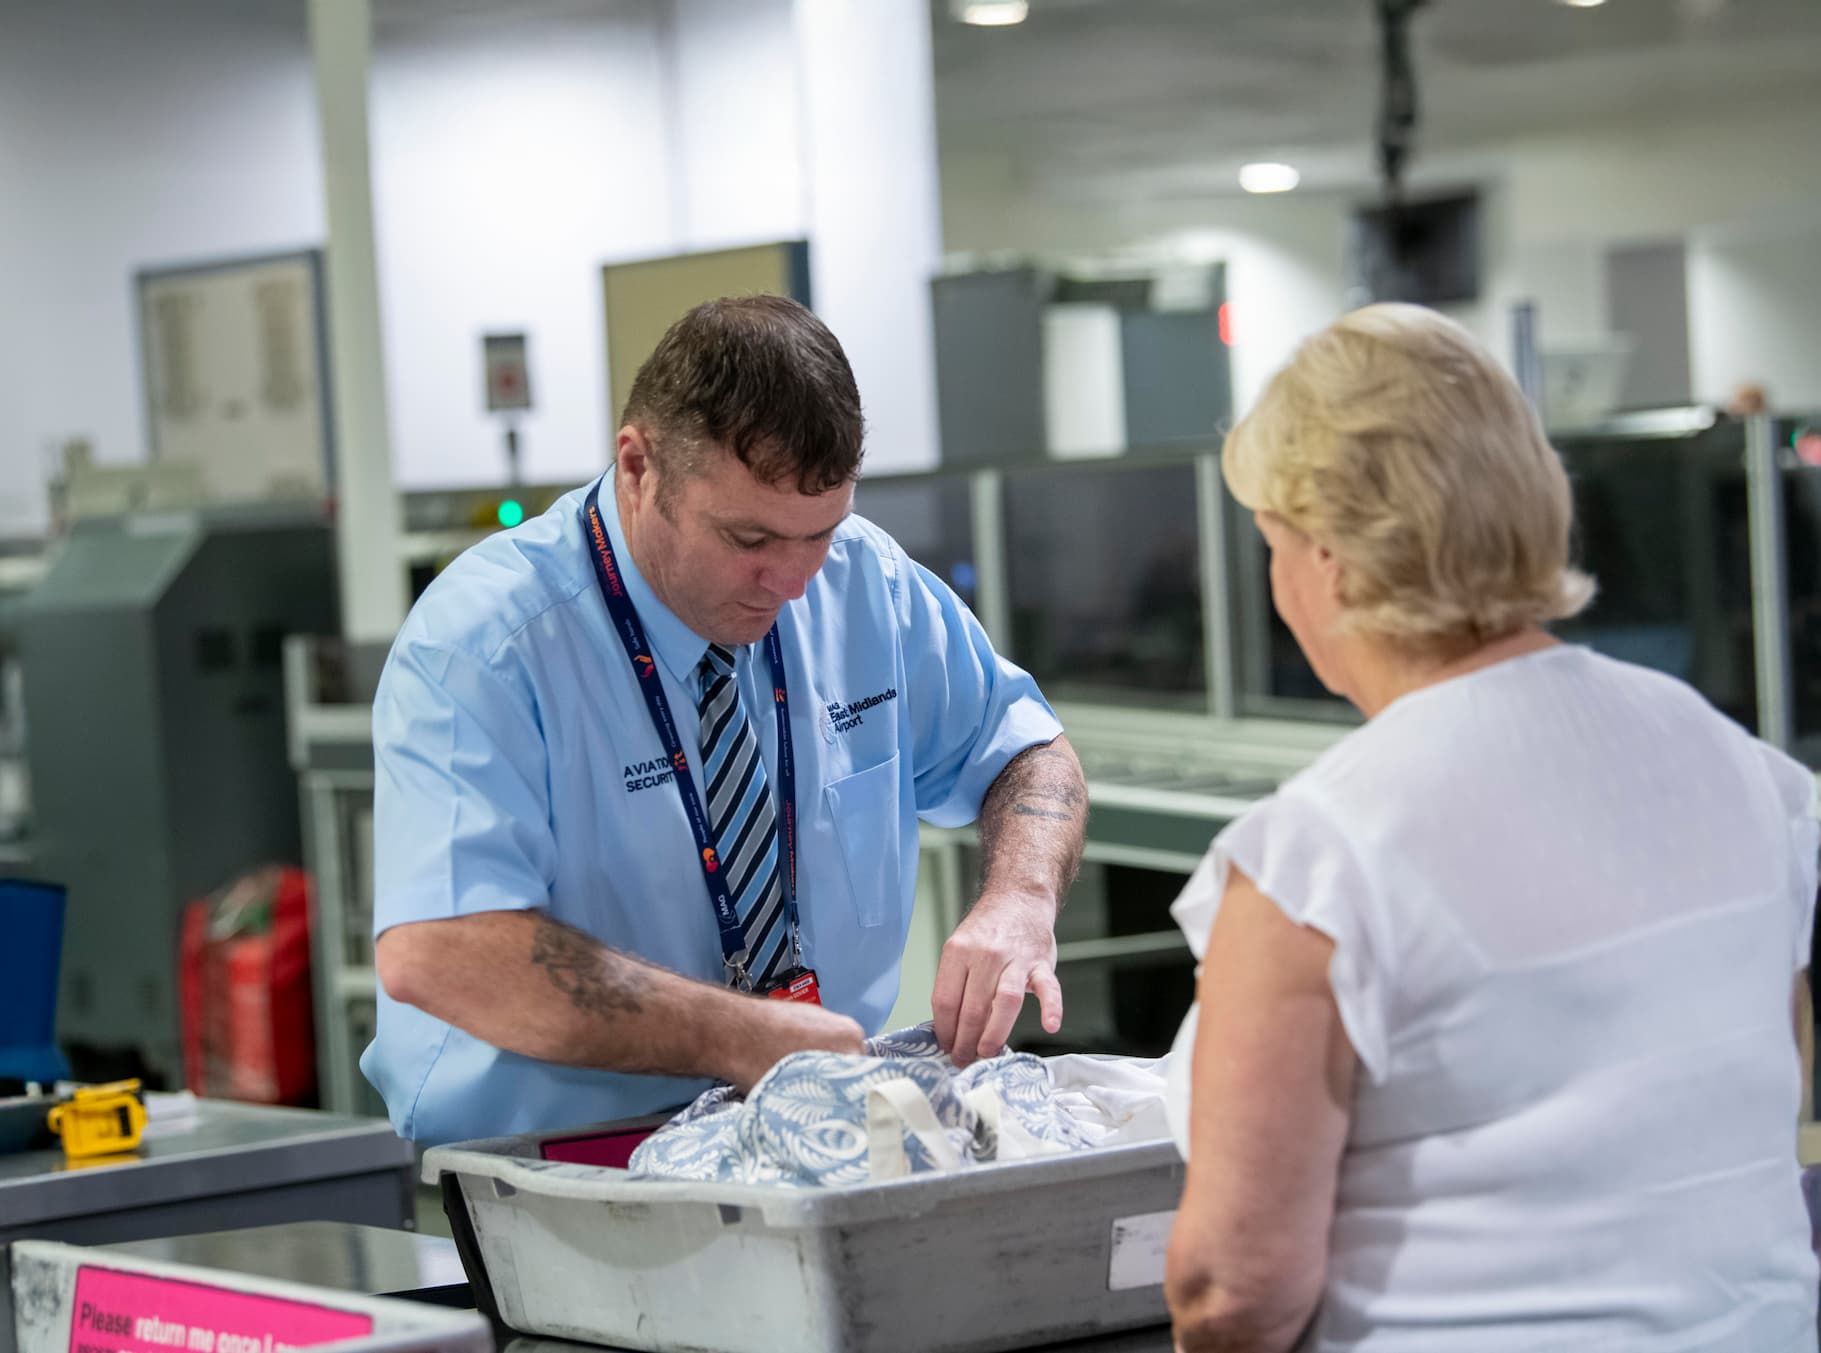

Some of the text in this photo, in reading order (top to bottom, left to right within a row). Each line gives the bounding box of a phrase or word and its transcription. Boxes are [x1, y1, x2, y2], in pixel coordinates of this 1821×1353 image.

[588, 505, 623, 597] Journey Makers
[830, 688, 897, 723] East Midlands
[834, 714, 864, 734] Airport
[626, 770, 675, 793] SECURIT
[718, 894, 729, 916] MAG
[80, 1301, 133, 1337] Please
[135, 1315, 186, 1347] return
[186, 1326, 215, 1353] me
